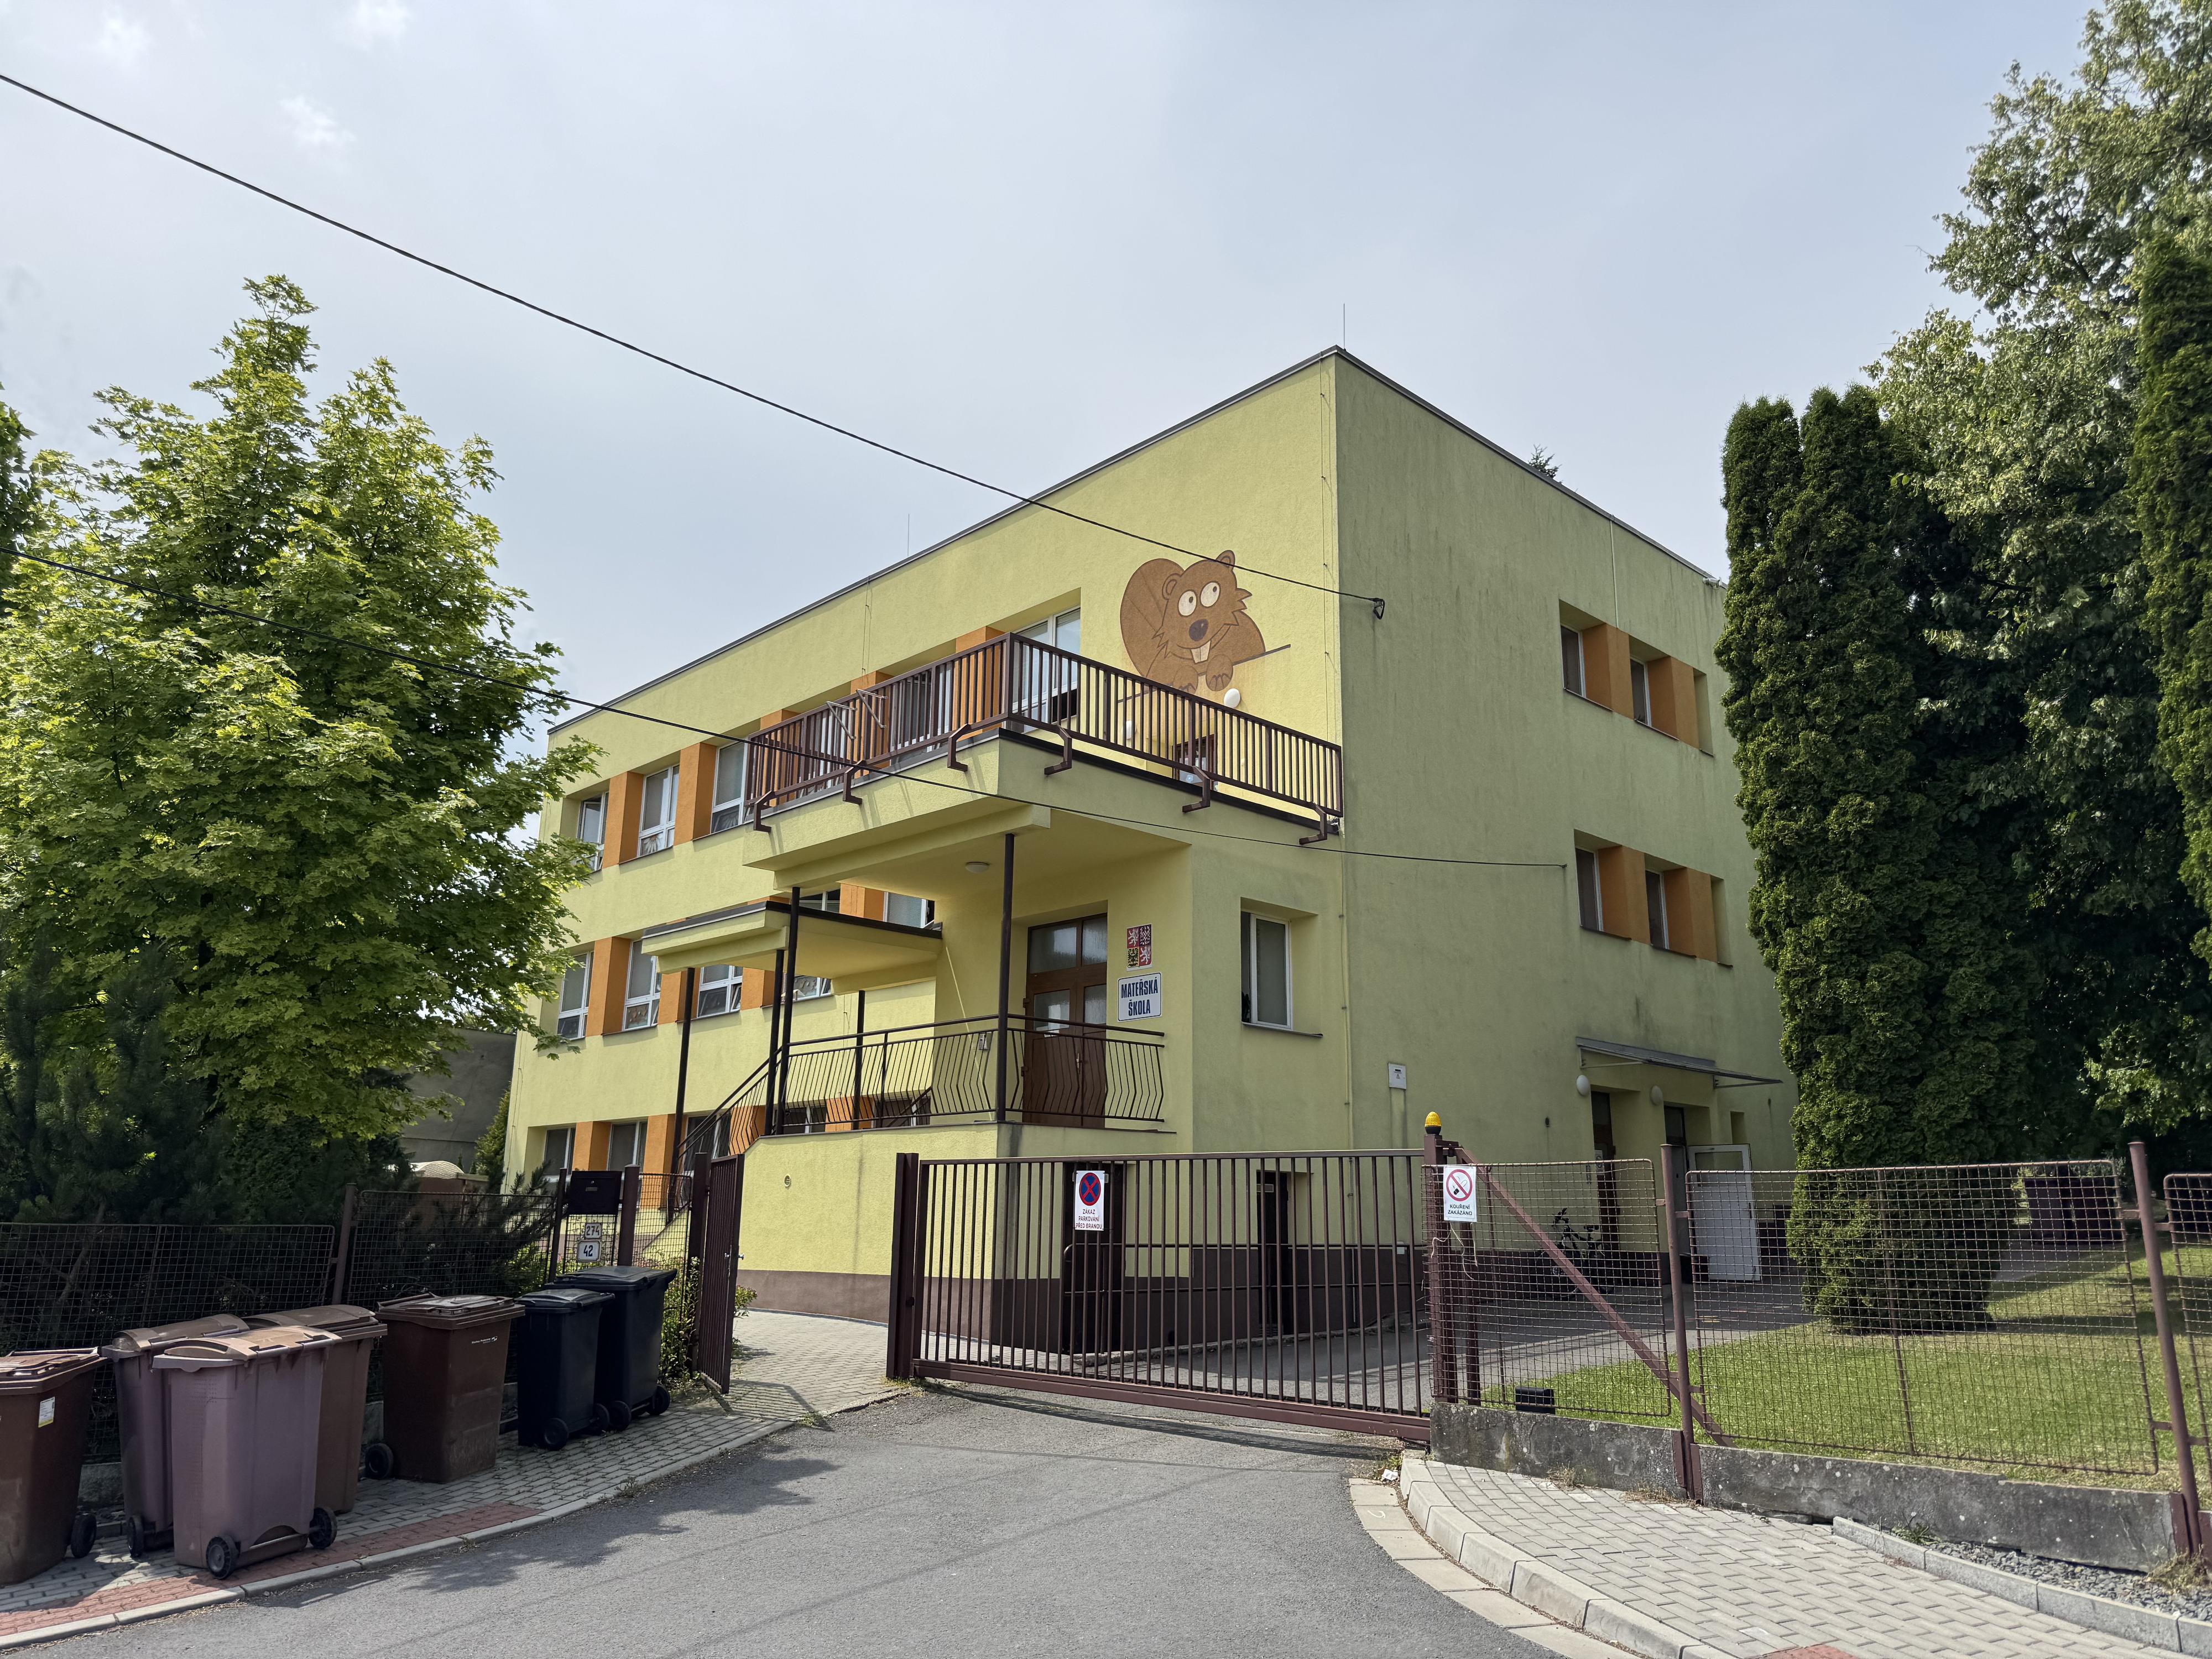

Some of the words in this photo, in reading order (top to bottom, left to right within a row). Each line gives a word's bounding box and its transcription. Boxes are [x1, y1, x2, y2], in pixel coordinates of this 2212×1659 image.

[1121, 977, 1159, 998] MATEŘSKÁ
[1128, 999, 1151, 1016] ŠKOLA
[586, 1225, 599, 1236] 274
[583, 1245, 593, 1257] 42
